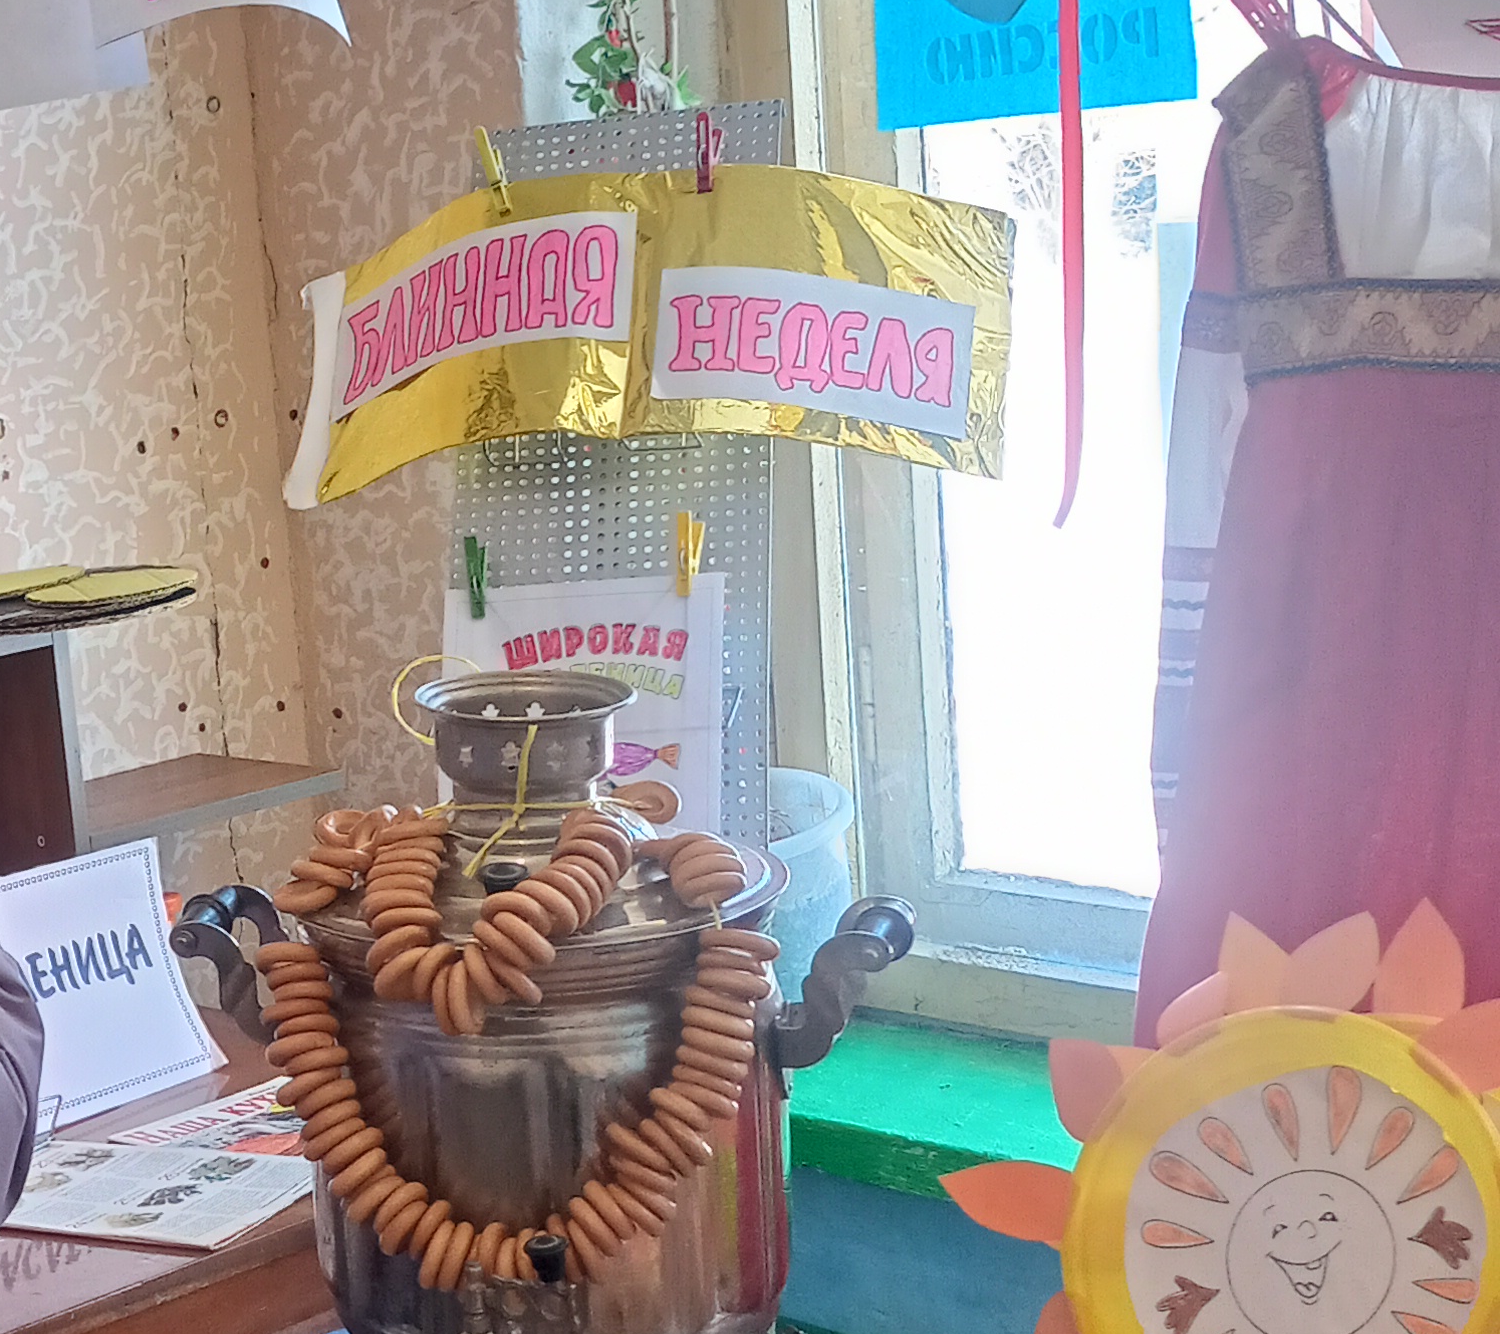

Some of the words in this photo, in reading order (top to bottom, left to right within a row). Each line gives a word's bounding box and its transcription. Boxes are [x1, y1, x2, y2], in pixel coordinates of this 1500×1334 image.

[342, 224, 619, 405] БЛИННАЯ
[668, 294, 956, 409] НЕДЕЛЯ
[502, 623, 689, 671] ШИРОКАЯ
[21, 923, 153, 1002] ЕНИЦА
[122, 1115, 231, 1146] НАША
